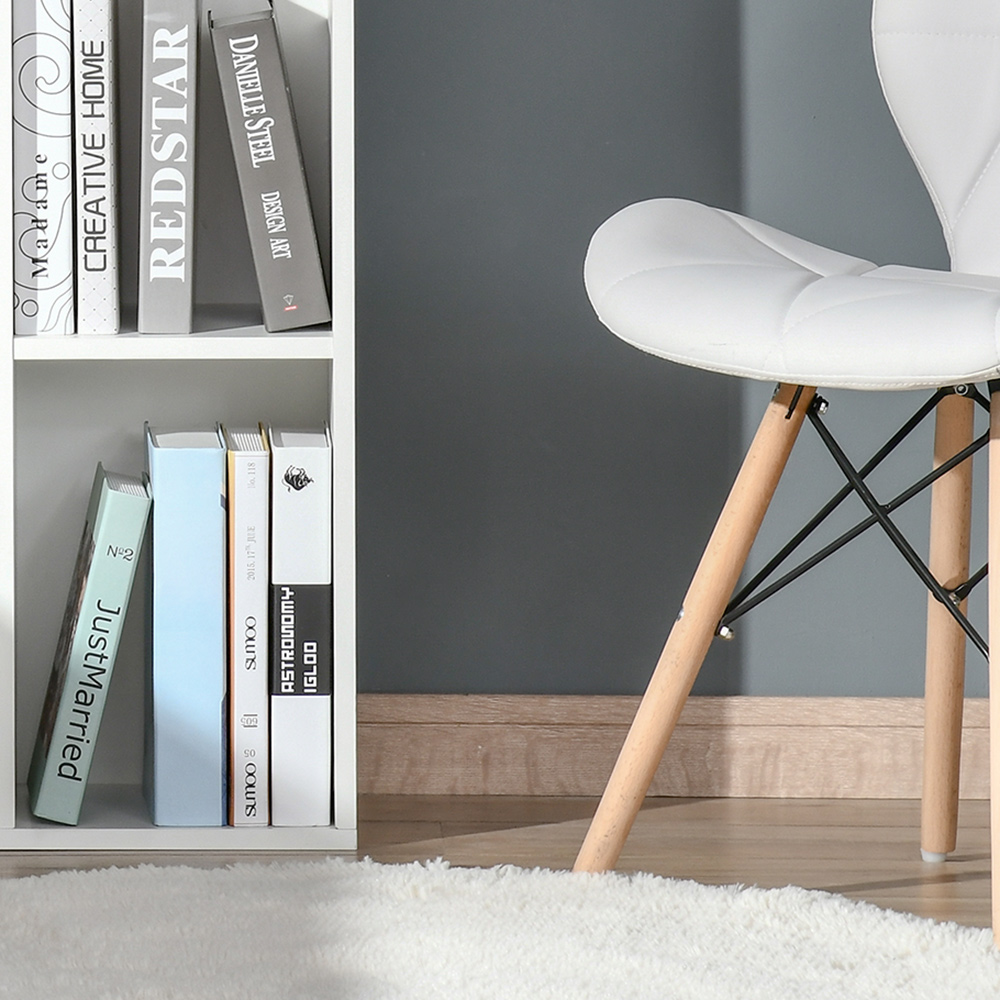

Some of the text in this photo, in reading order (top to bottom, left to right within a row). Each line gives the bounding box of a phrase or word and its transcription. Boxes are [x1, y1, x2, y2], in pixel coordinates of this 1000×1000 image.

[149, 24, 190, 284] REDSTAR
[229, 34, 276, 168] DANIELLE STEEL
[83, 40, 107, 273] CREATIVE HOME
[31, 154, 49, 279] Madame
[260, 190, 292, 260] DESIGN ART
[247, 462, 256, 475] 118
[247, 561, 256, 581] 2015.
[57, 599, 122, 782] JustMarried
[281, 586, 295, 693] ASTRONOMY
[303, 641, 317, 693] IGLOO
[243, 749, 256, 758] 05
